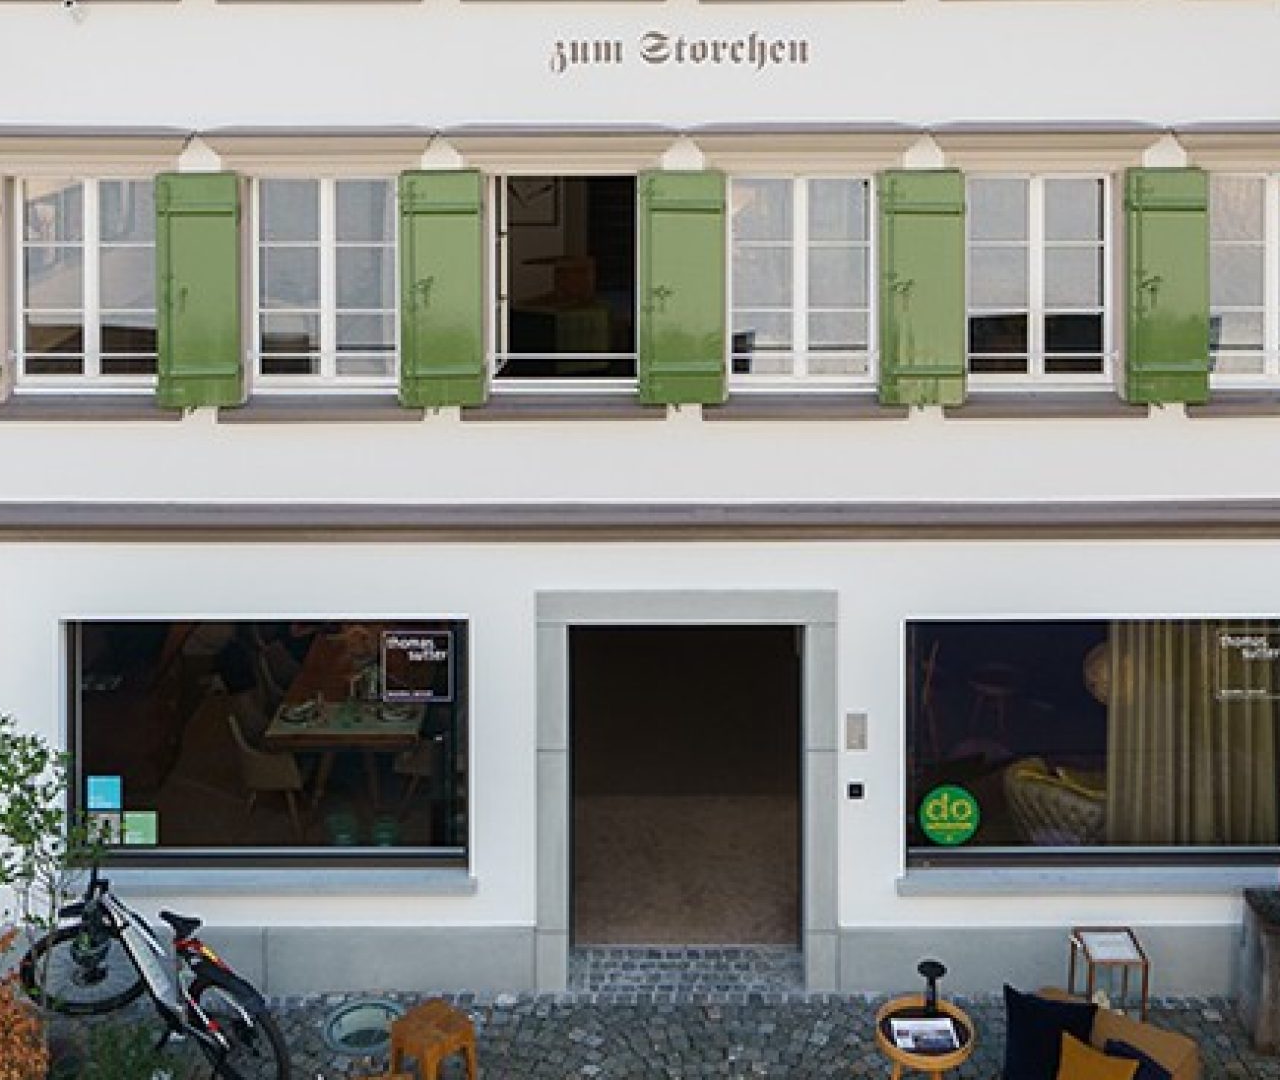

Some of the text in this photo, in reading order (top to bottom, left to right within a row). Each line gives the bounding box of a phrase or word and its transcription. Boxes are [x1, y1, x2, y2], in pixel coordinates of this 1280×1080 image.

[551, 30, 810, 73] zum Storchen
[386, 635, 435, 650] thomas
[1219, 634, 1269, 649] thomas
